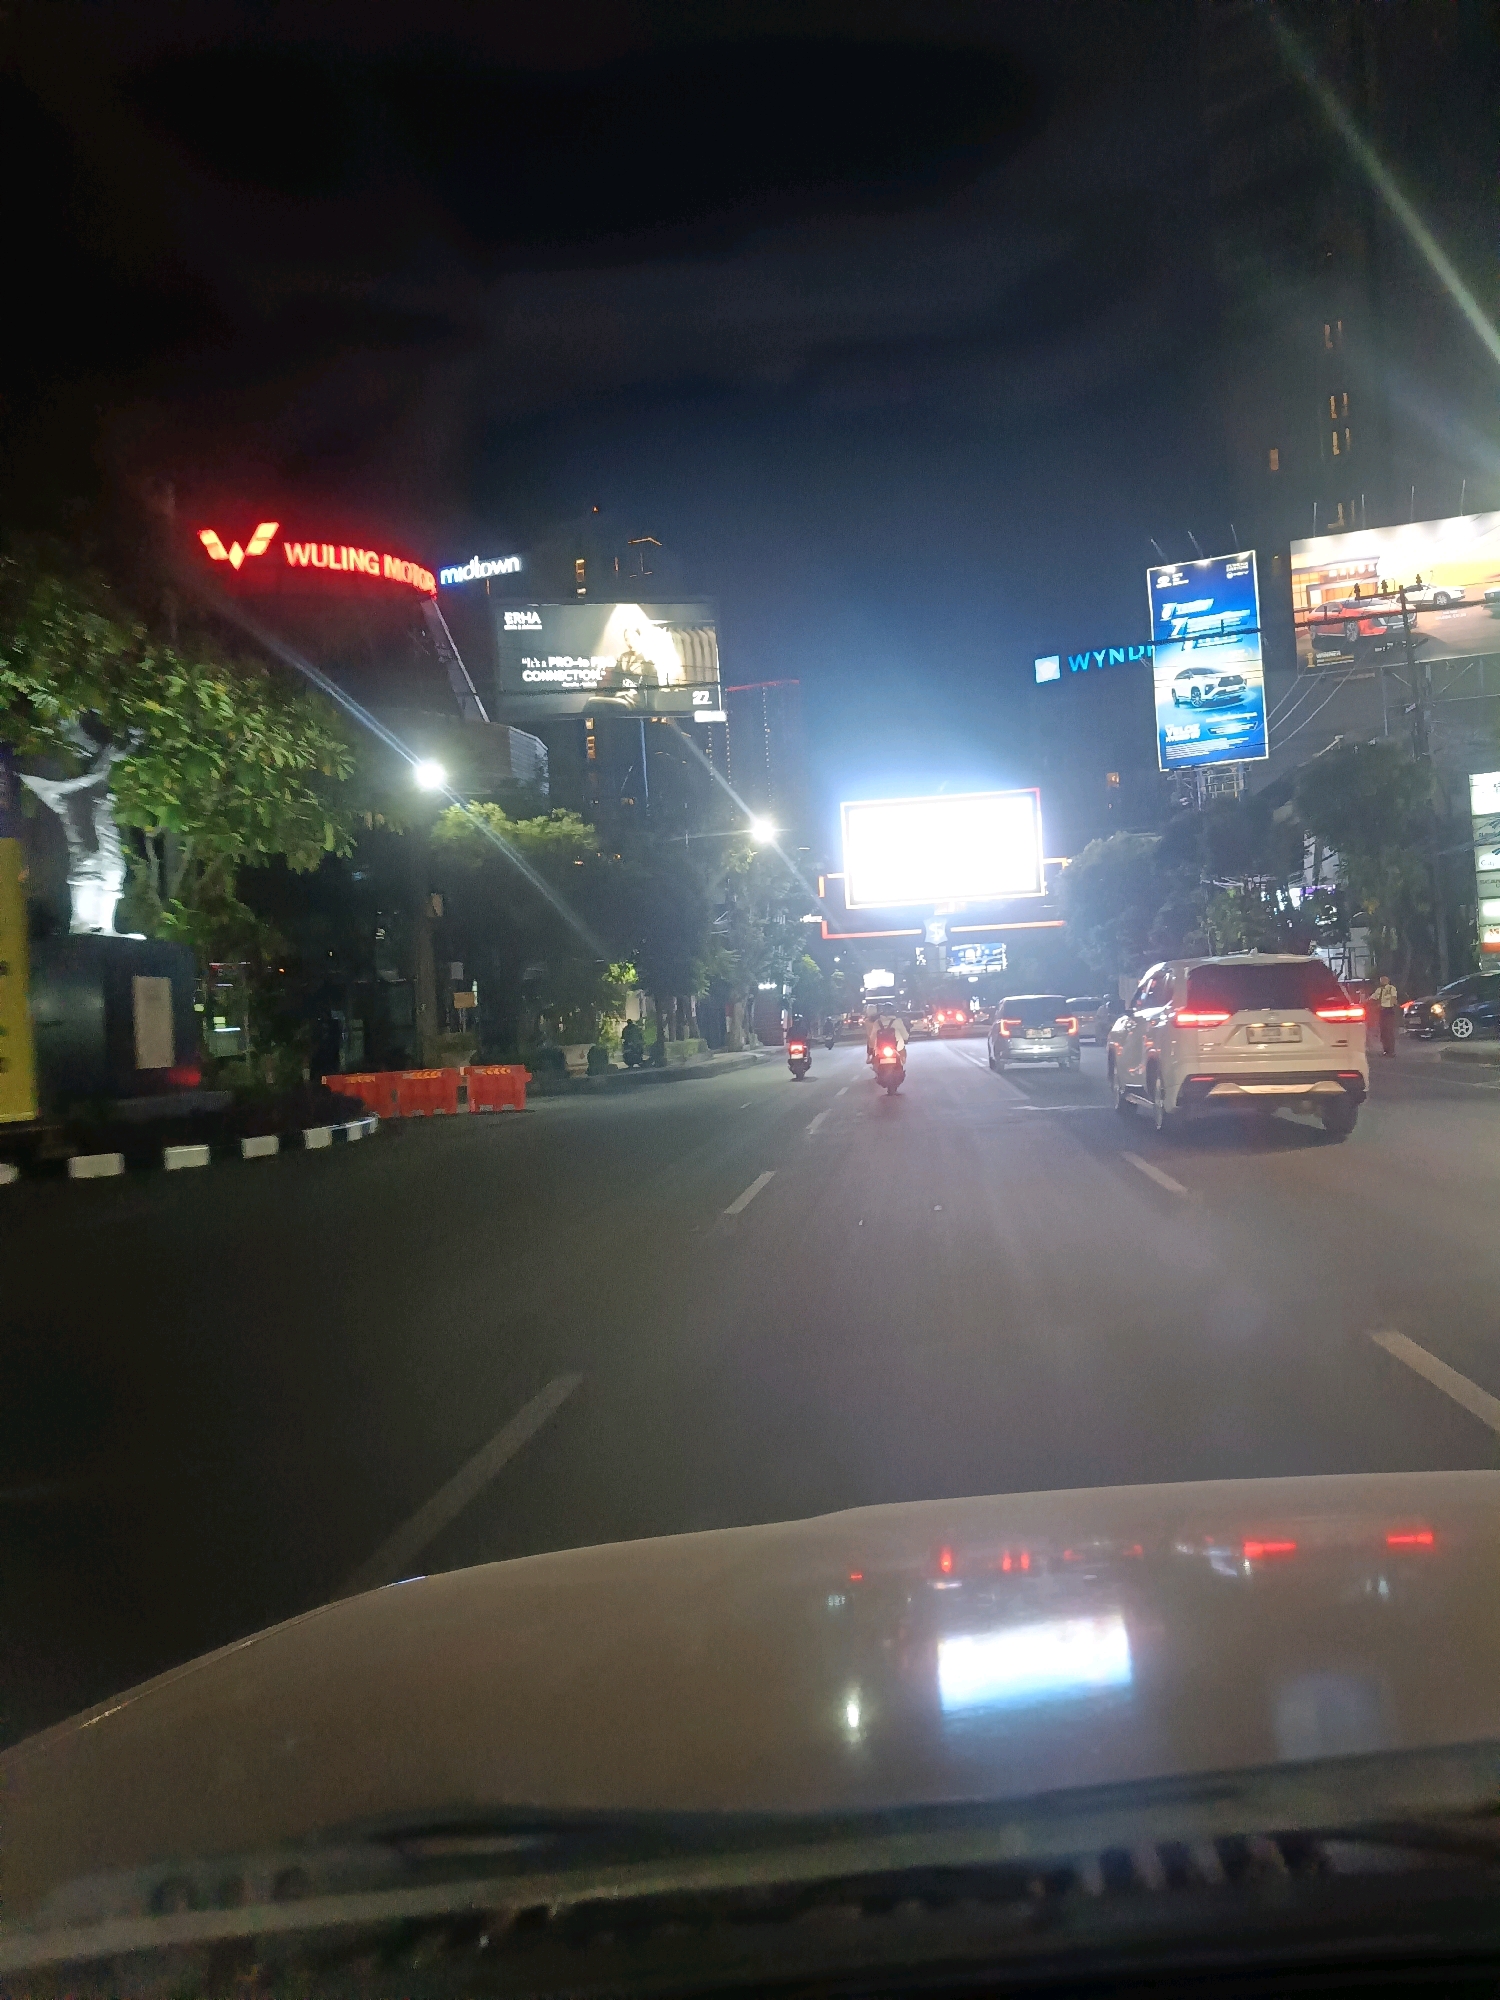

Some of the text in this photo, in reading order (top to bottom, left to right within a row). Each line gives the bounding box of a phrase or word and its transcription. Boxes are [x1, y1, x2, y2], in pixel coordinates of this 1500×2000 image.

[284, 542, 380, 576] WULING
[440, 555, 520, 585] midtown
[504, 611, 541, 624] ERHA
